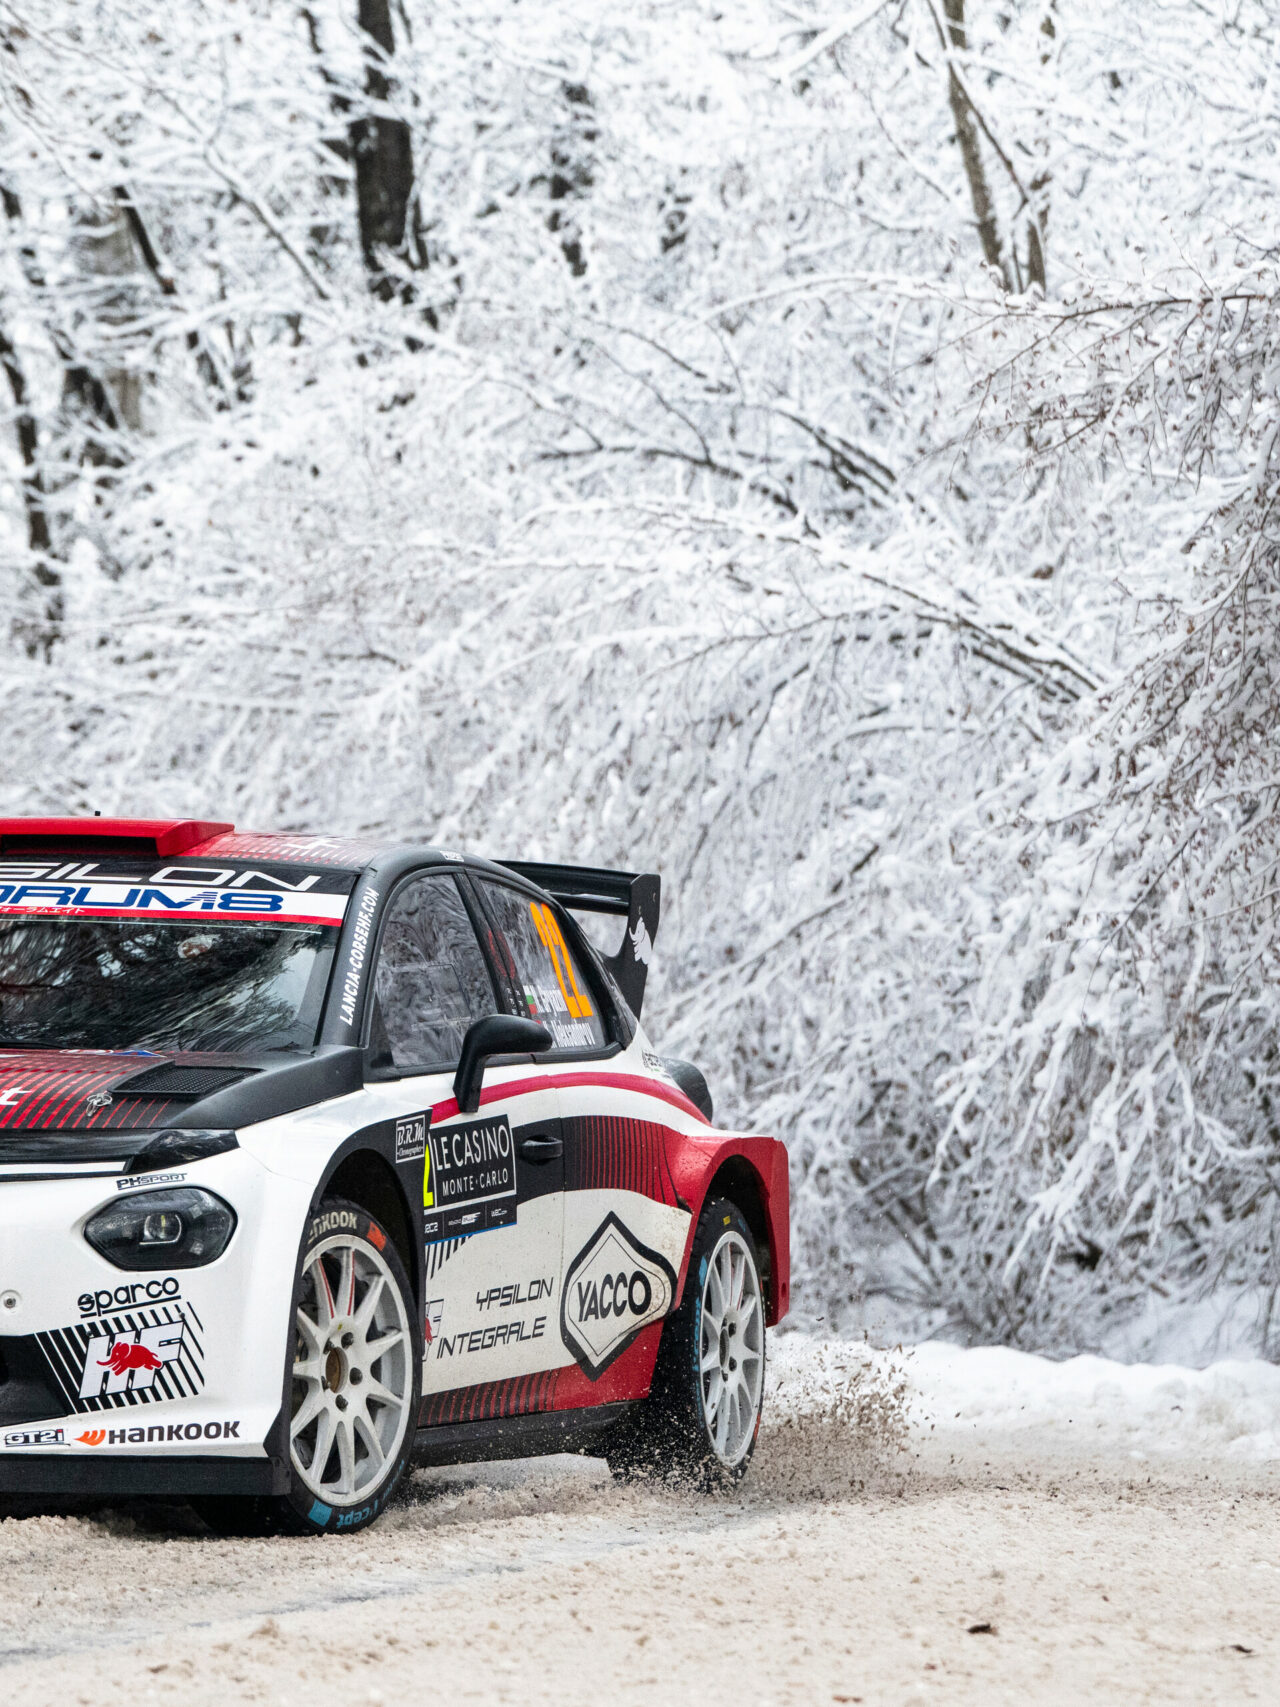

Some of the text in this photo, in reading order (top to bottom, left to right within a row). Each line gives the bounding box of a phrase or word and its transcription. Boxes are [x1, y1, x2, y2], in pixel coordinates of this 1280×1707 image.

[339, 886, 380, 1027] LANCIA-CORSEHF.COM
[433, 1124, 510, 1171] LE CASINO
[77, 1276, 180, 1316] sparco
[476, 1277, 554, 1311] YPSILON
[577, 1270, 653, 1323] YACCO
[437, 1315, 548, 1360] INTEGRALE
